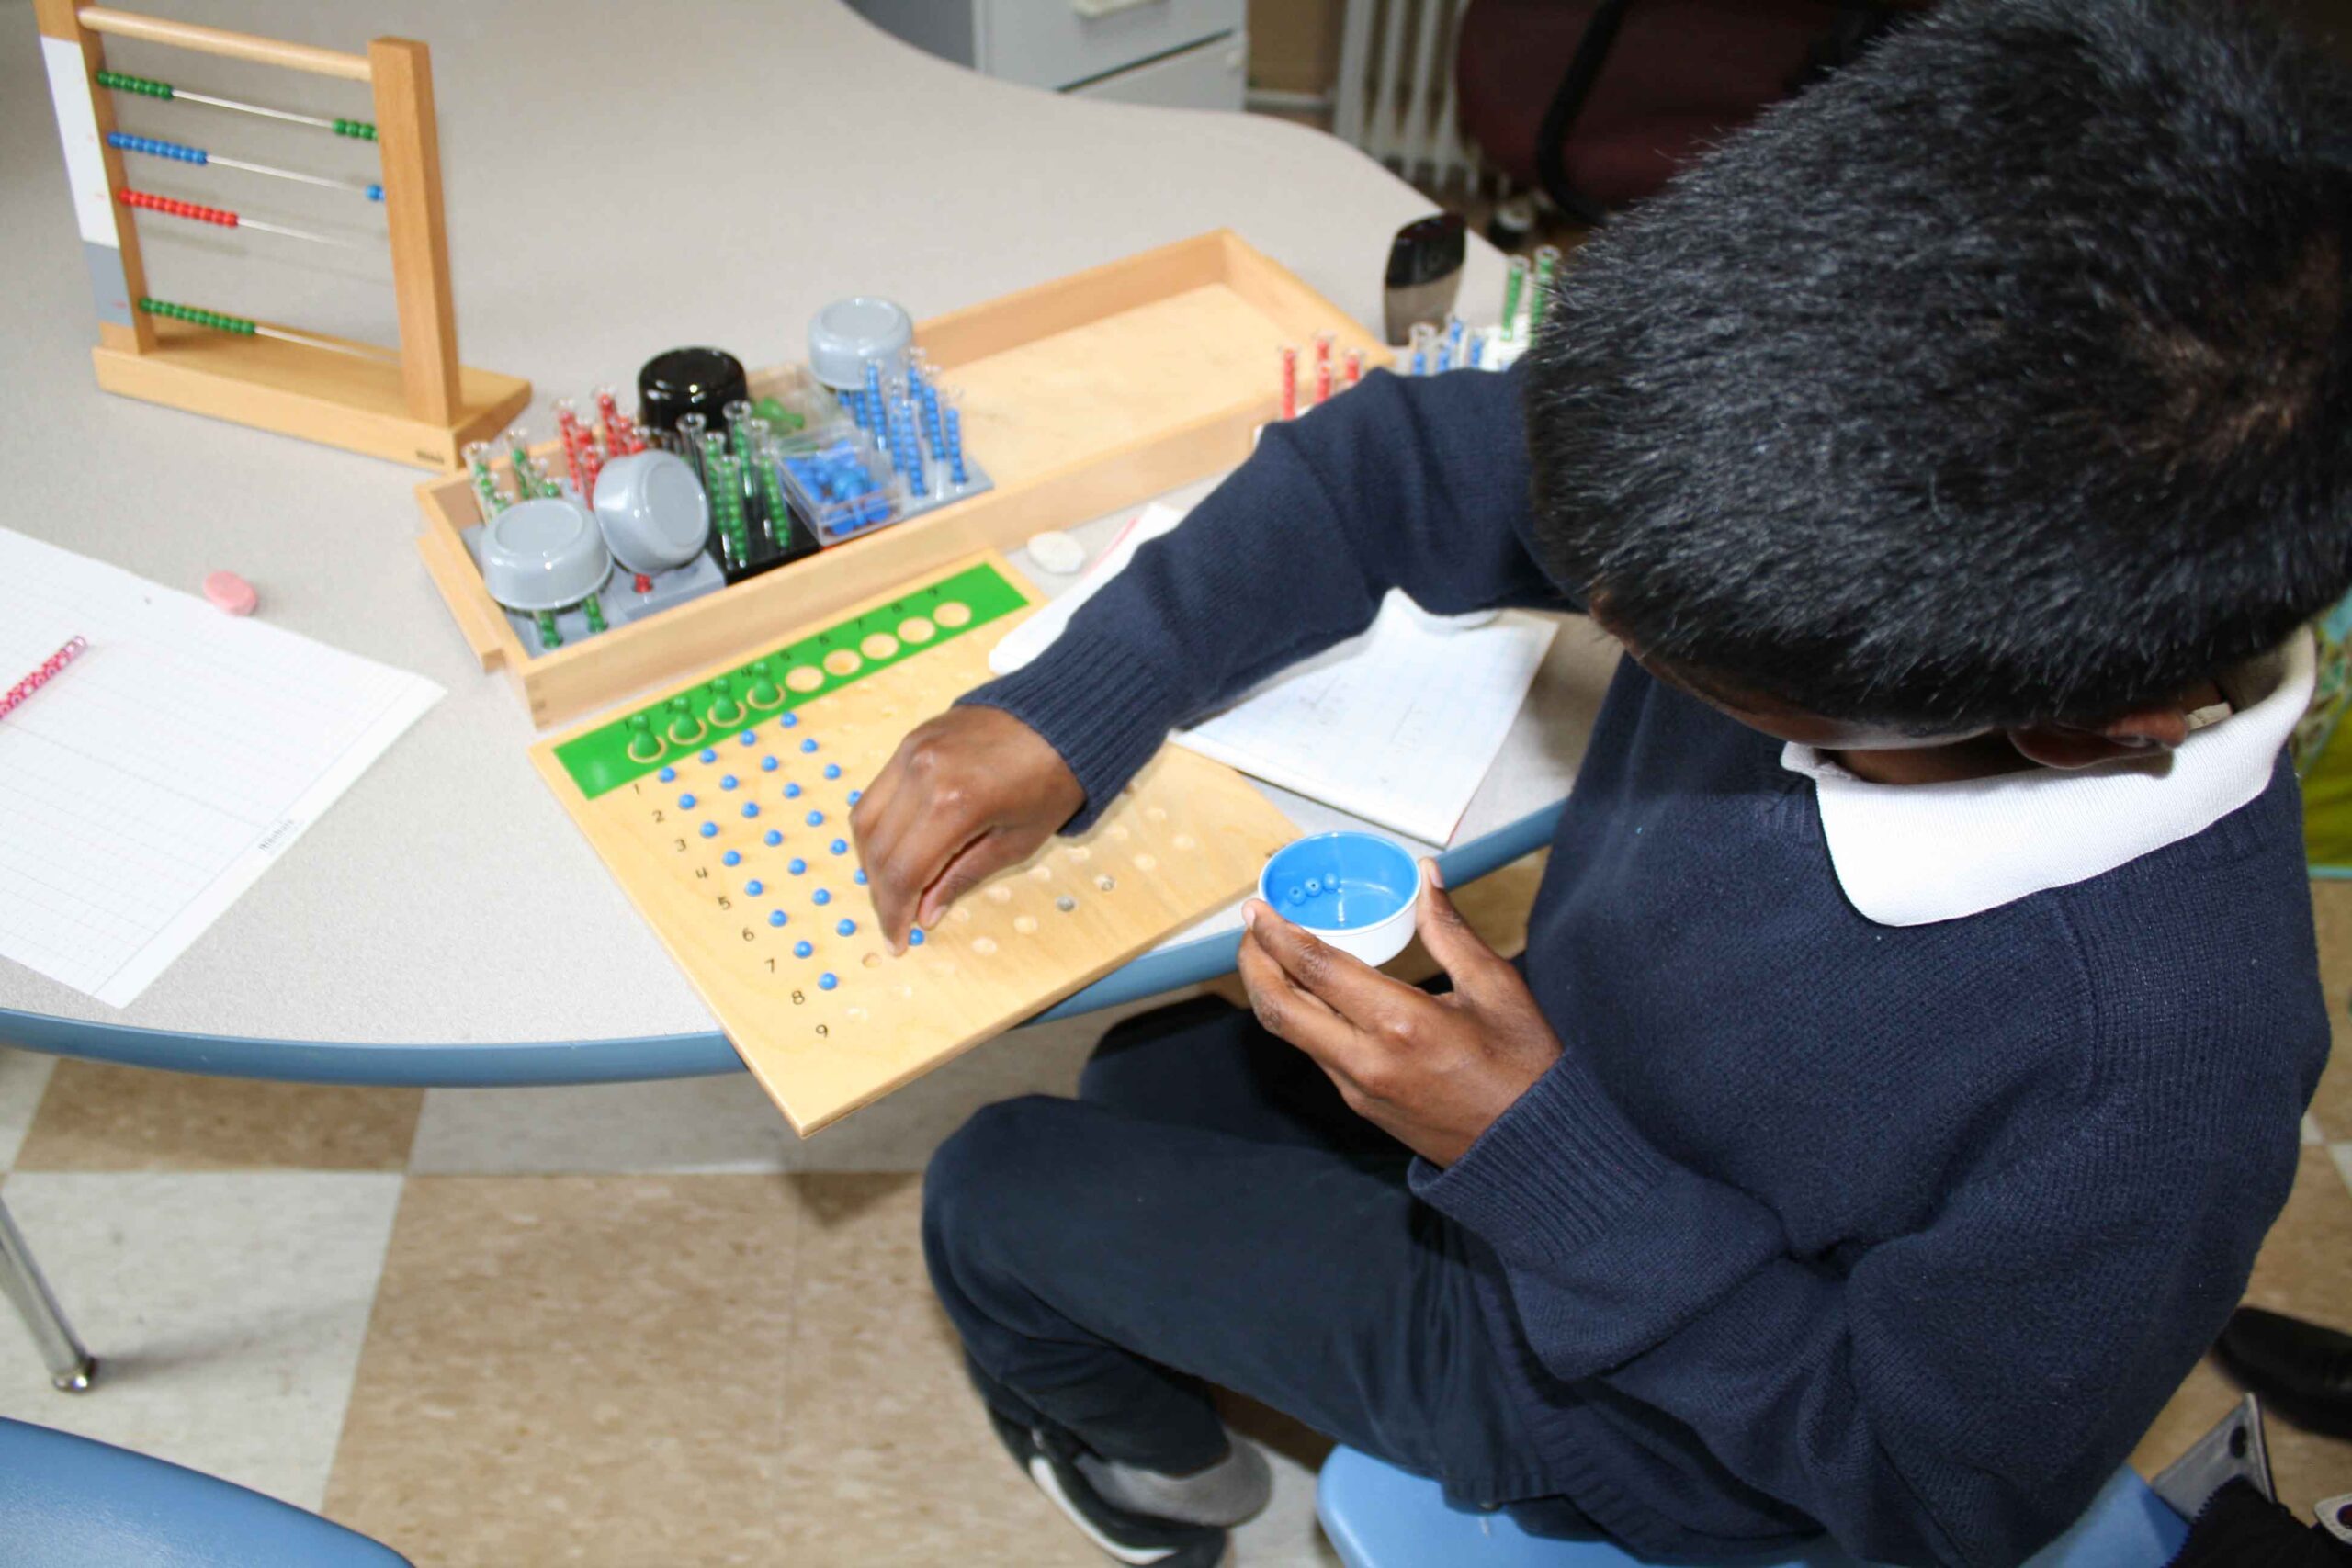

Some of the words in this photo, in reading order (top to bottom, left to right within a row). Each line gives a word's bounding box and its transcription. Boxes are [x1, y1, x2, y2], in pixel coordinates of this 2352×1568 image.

[634, 783, 639, 795] 1
[652, 809, 664, 823] 2
[674, 838, 687, 852] 3
[695, 866, 708, 879] 4
[718, 895, 731, 910] 5
[742, 927, 755, 942] 6
[764, 957, 775, 974] 7
[791, 990, 805, 1005] 8
[815, 1023, 829, 1038] 9
